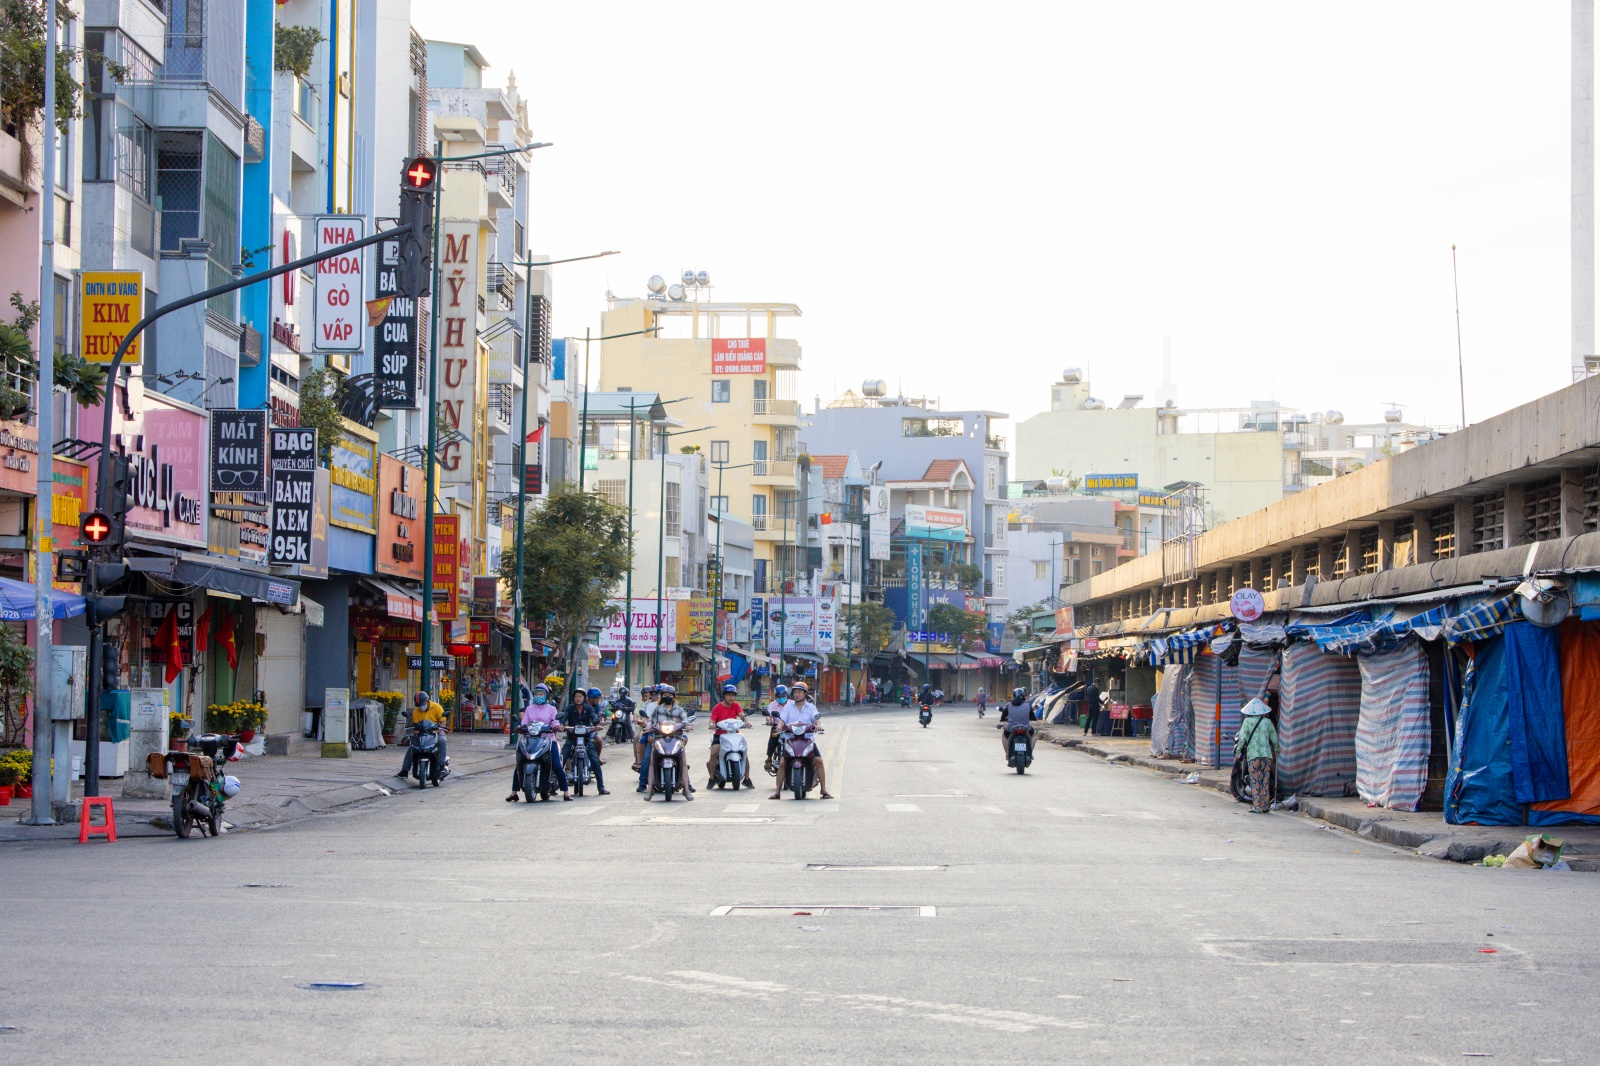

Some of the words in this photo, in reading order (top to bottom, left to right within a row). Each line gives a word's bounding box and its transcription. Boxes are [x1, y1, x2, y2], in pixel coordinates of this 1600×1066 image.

[323, 227, 355, 244] NHA
[318, 256, 360, 274] KHOA
[86, 282, 104, 295] DNTN
[107, 282, 116, 295] KD
[119, 280, 137, 295] VÀNG
[327, 283, 350, 306] GÒ
[93, 303, 130, 323] KIM
[386, 297, 414, 317] ANH
[323, 317, 353, 341] VẤP
[383, 322, 409, 343] CUA
[85, 331, 136, 356] HƯNG
[728, 339, 737, 349] CHO
[382, 350, 408, 375] SÚP
[222, 416, 257, 439] MẮT
[275, 432, 313, 455] BẠC
[219, 443, 258, 465] KÍNH
[272, 456, 295, 469] NGUYÊN
[297, 455, 313, 469] CHẤT
[275, 474, 312, 503] BÁNH
[1087, 478, 1098, 488] NHA
[1100, 477, 1113, 488] KHOA
[179, 492, 200, 524] CAKE
[276, 508, 308, 531] KEM
[434, 521, 454, 538] TIỆM
[274, 536, 308, 561] 95k
[434, 541, 454, 555] VÀNG
[437, 563, 452, 575] KIM
[911, 558, 919, 590] LONG
[911, 592, 919, 627] CHÂU
[606, 612, 667, 630] JEWELRY
[609, 632, 626, 642] Trang
[819, 631, 832, 639] 7K
[411, 656, 422, 668] SÚ
